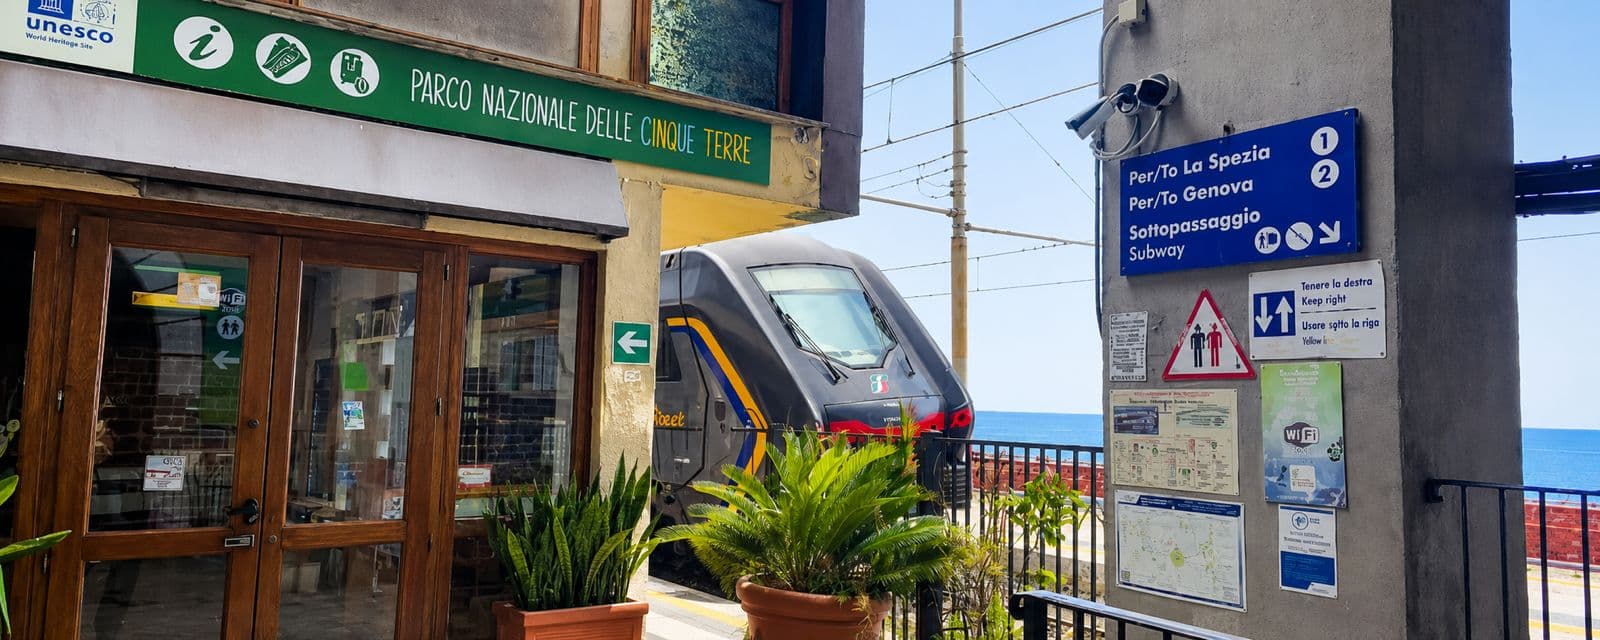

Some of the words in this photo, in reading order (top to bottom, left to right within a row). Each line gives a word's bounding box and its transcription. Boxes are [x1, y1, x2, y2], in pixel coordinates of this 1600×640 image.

[27, 16, 113, 43] unesco
[26, 32, 46, 41] World
[48, 37, 78, 48] Heritage
[411, 69, 472, 110] PARCO
[482, 84, 578, 132] NAZIONALE
[586, 105, 633, 143] DELLE
[641, 116, 695, 154] CINQUE
[704, 128, 752, 164] TERRE
[1319, 133, 1328, 149] 1
[1129, 164, 1177, 186] Per/To
[1183, 159, 1203, 175] La
[1208, 145, 1270, 172] Spezia
[1318, 165, 1331, 183] 2
[1129, 191, 1178, 211] Per/To
[1183, 178, 1253, 202] Genova
[1129, 207, 1261, 241] Sottopassaggio
[1129, 244, 1185, 262] Subway
[1301, 281, 1330, 291] Tenere
[1333, 279, 1341, 288] la
[1344, 278, 1373, 288] destra
[1301, 297, 1323, 307] Keep
[1326, 294, 1346, 306] right
[1302, 321, 1326, 331] Usare
[1352, 318, 1359, 328] la
[1362, 317, 1380, 329] riga
[1302, 335, 1322, 346] Yellow
